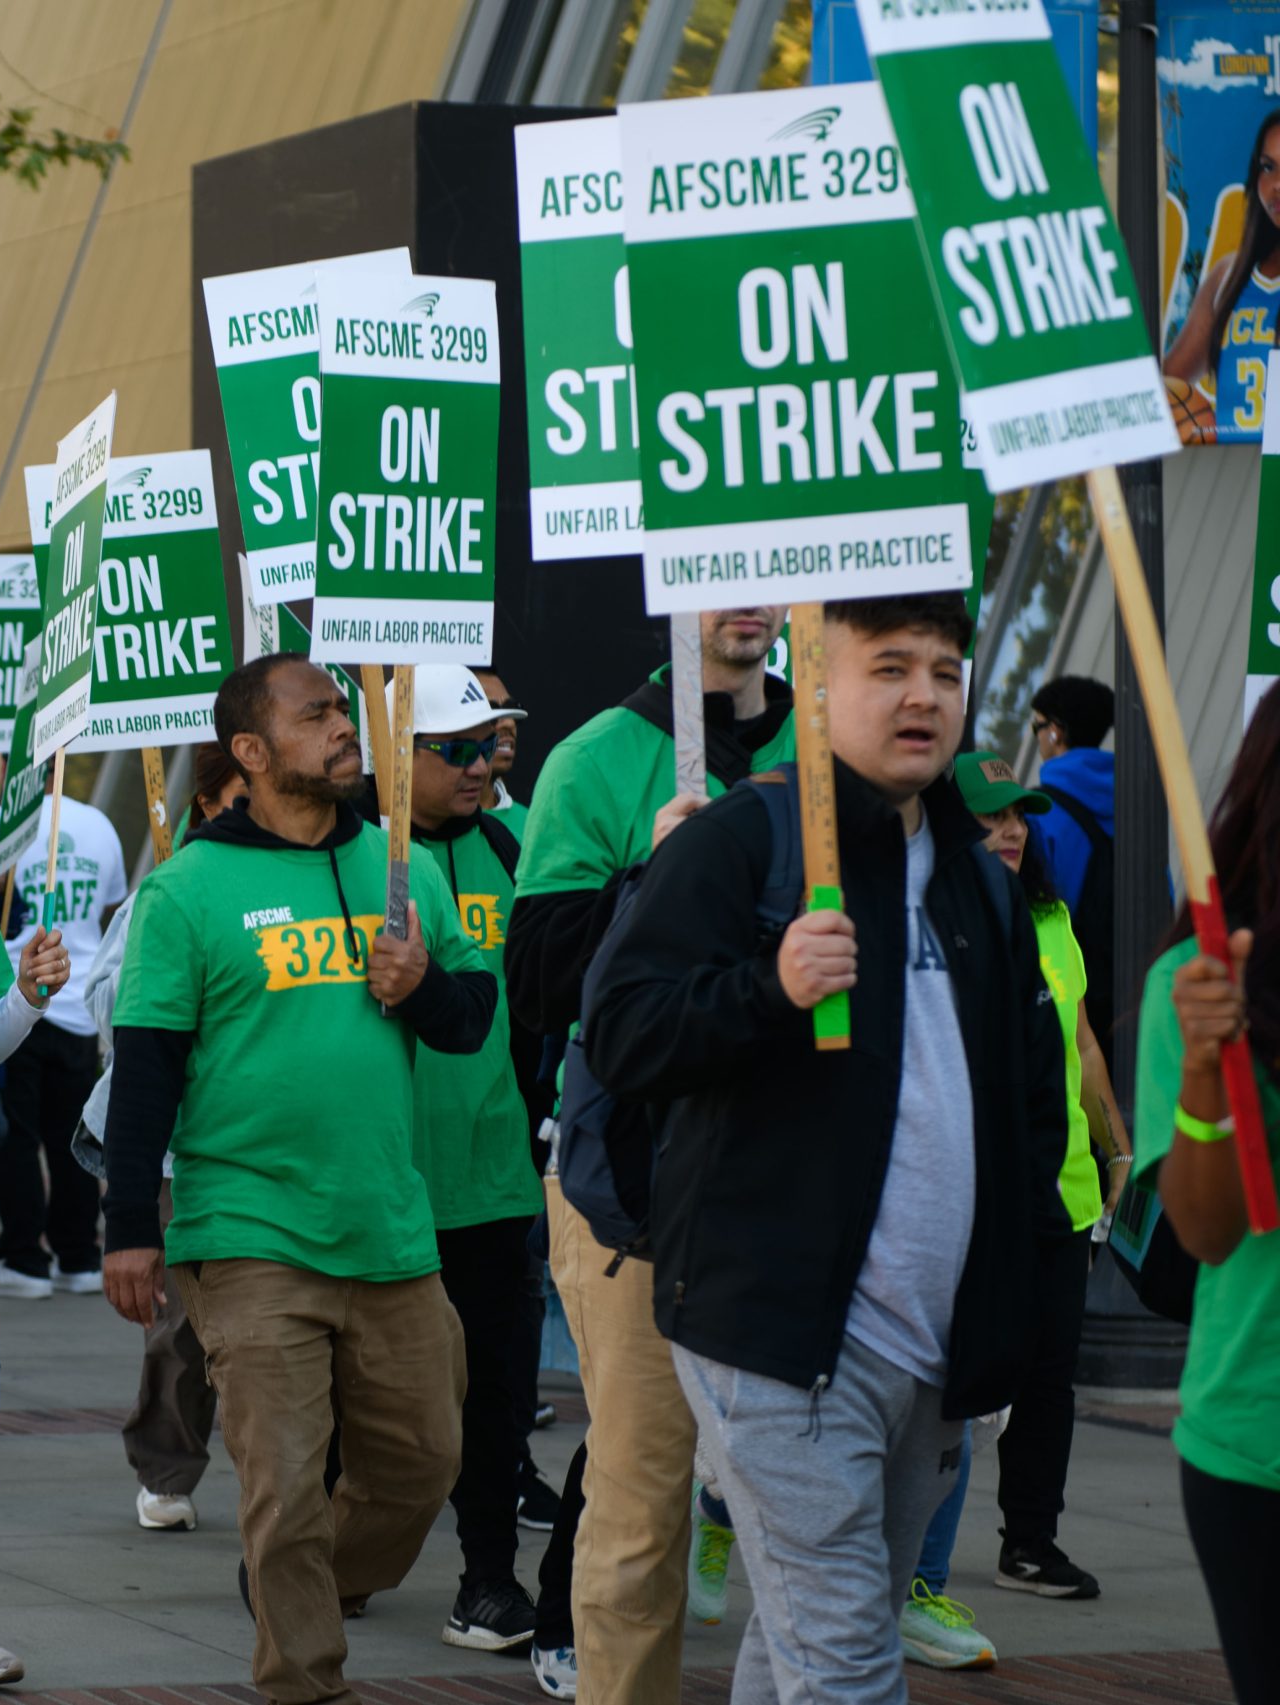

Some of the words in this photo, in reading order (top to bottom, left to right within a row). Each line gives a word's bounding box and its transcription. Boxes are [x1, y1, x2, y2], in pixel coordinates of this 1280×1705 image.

[959, 81, 1050, 201] ON
[540, 170, 623, 219] AFSC
[649, 153, 809, 214] AFSCME
[822, 145, 912, 198] 329
[941, 205, 1133, 346] STRIKE
[227, 303, 320, 348] AFSCM
[334, 317, 424, 360] AFSCME
[431, 326, 488, 364] 3299
[737, 261, 848, 370] ON
[291, 376, 320, 443] O
[656, 370, 943, 493] STRIKE
[56, 454, 85, 508] AFSCME
[84, 435, 107, 482] 3299
[380, 404, 441, 484] ON
[142, 487, 204, 520] 3299
[546, 507, 619, 537] UNFAIR
[63, 520, 86, 597] ON
[327, 492, 485, 575] STRIKE
[661, 551, 749, 587] UNFAIR
[755, 543, 833, 579] LABOR
[839, 533, 953, 573] PRACTICE
[20, 579, 39, 598] 32
[99, 555, 164, 616] ON
[260, 561, 315, 587] UNFAIR
[42, 584, 95, 685] STRIKE
[93, 615, 222, 683] TRIKE
[321, 619, 372, 643] UNFAIR
[375, 620, 419, 645] LABOR
[422, 622, 484, 646] PRACTICE
[36, 717, 52, 749] UNFAIR
[51, 710, 66, 737] LABOR
[65, 692, 88, 725] PRACTICE
[117, 714, 162, 735] LABOR
[165, 708, 215, 730] PRACTI
[243, 906, 294, 930] AFSCME
[280, 926, 385, 978] 329
